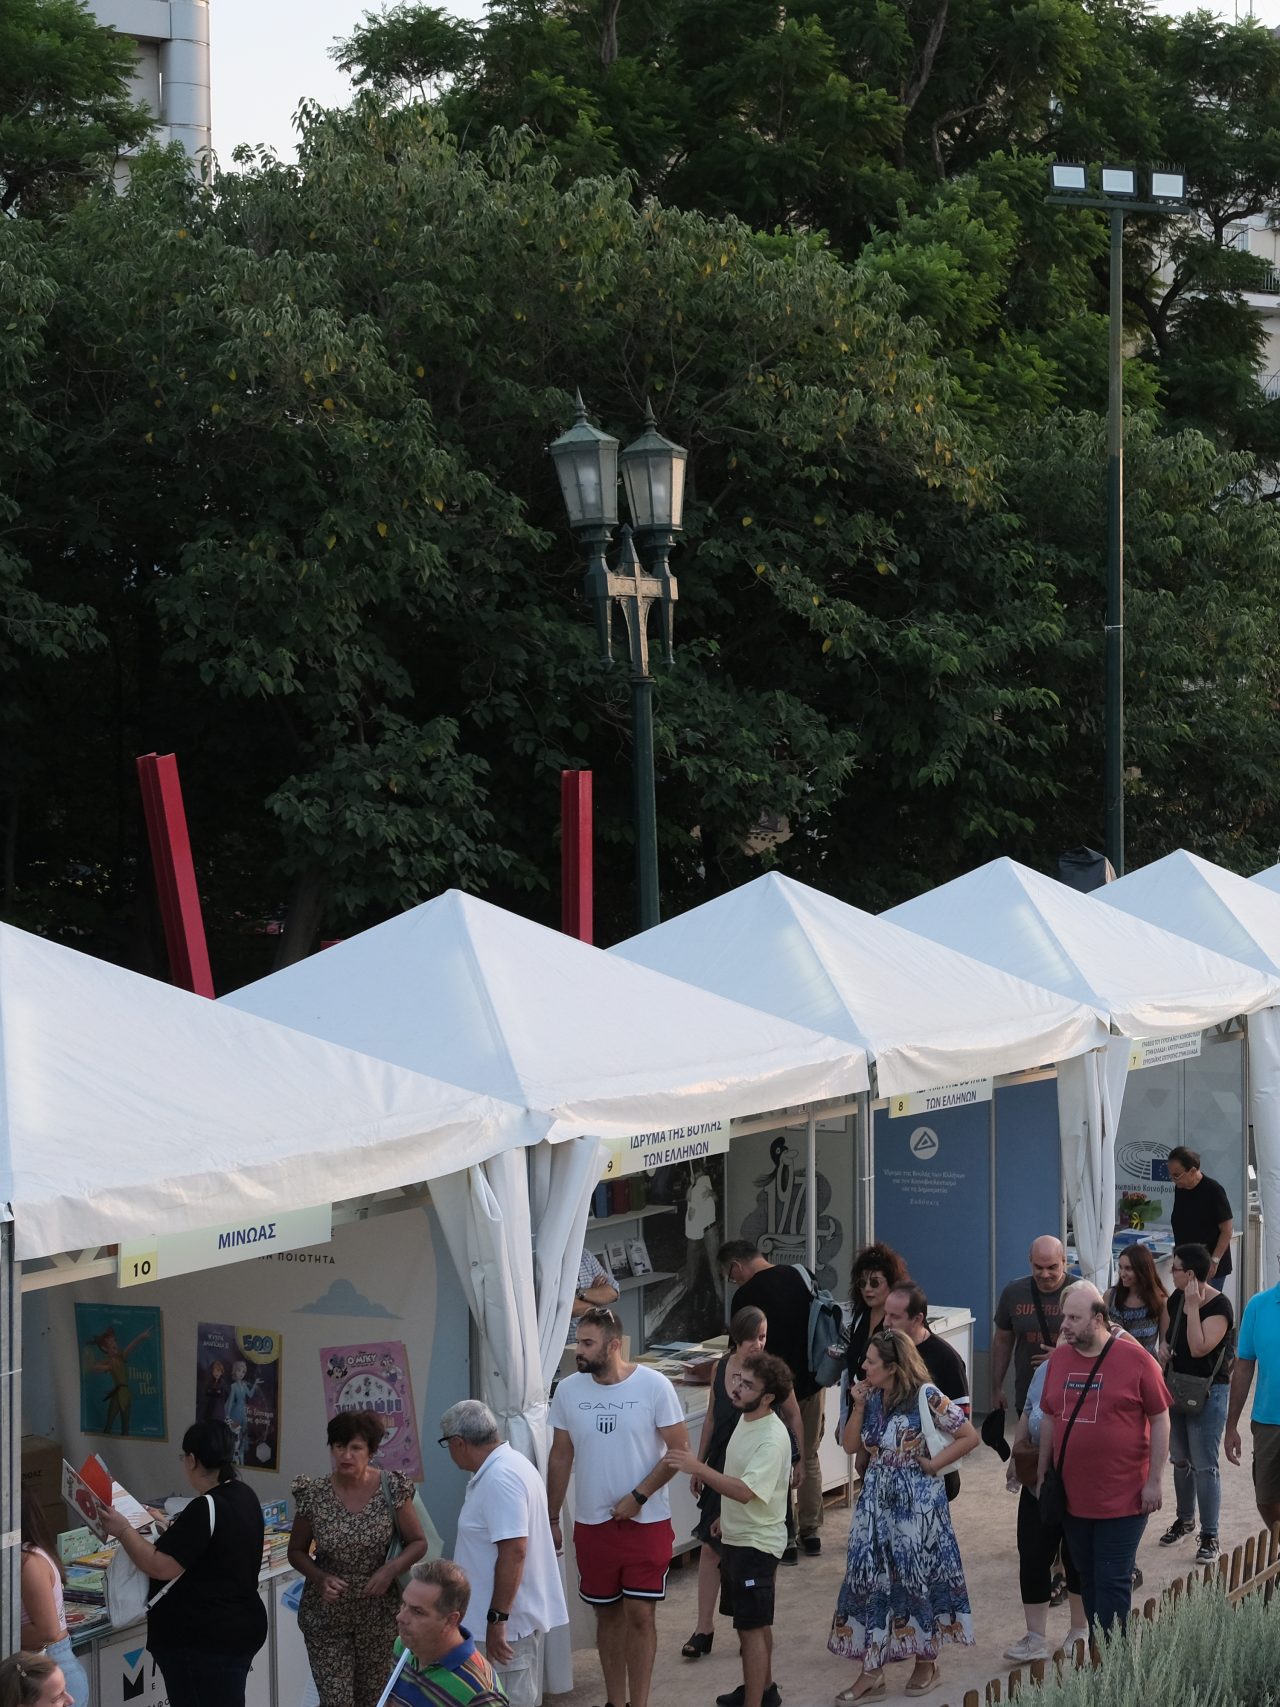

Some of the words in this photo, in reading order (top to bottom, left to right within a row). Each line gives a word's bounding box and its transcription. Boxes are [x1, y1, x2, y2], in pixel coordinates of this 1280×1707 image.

[898, 1101, 904, 1111] 8
[925, 1097, 941, 1110] ΤΩΝ
[942, 1089, 977, 1107] ΕΛΛΗΝΩΝ
[630, 1131, 666, 1149] ΙΔΡΥΜΑ
[667, 1127, 685, 1141] ΤΗΣ
[687, 1120, 722, 1138] ΒΟΥΛΗΣ
[643, 1153, 663, 1167] ΤΩΝ
[664, 1140, 709, 1163] ΕΛΛΗΝΩΝ
[607, 1160, 614, 1173] 9
[218, 1223, 276, 1249] ΜΙΝΩΑΣ
[277, 1252, 335, 1265] ΠΟΙΟΤΗΤΑ
[133, 1260, 151, 1277] 10
[242, 1334, 274, 1355] 500
[578, 1401, 640, 1411] GANT
